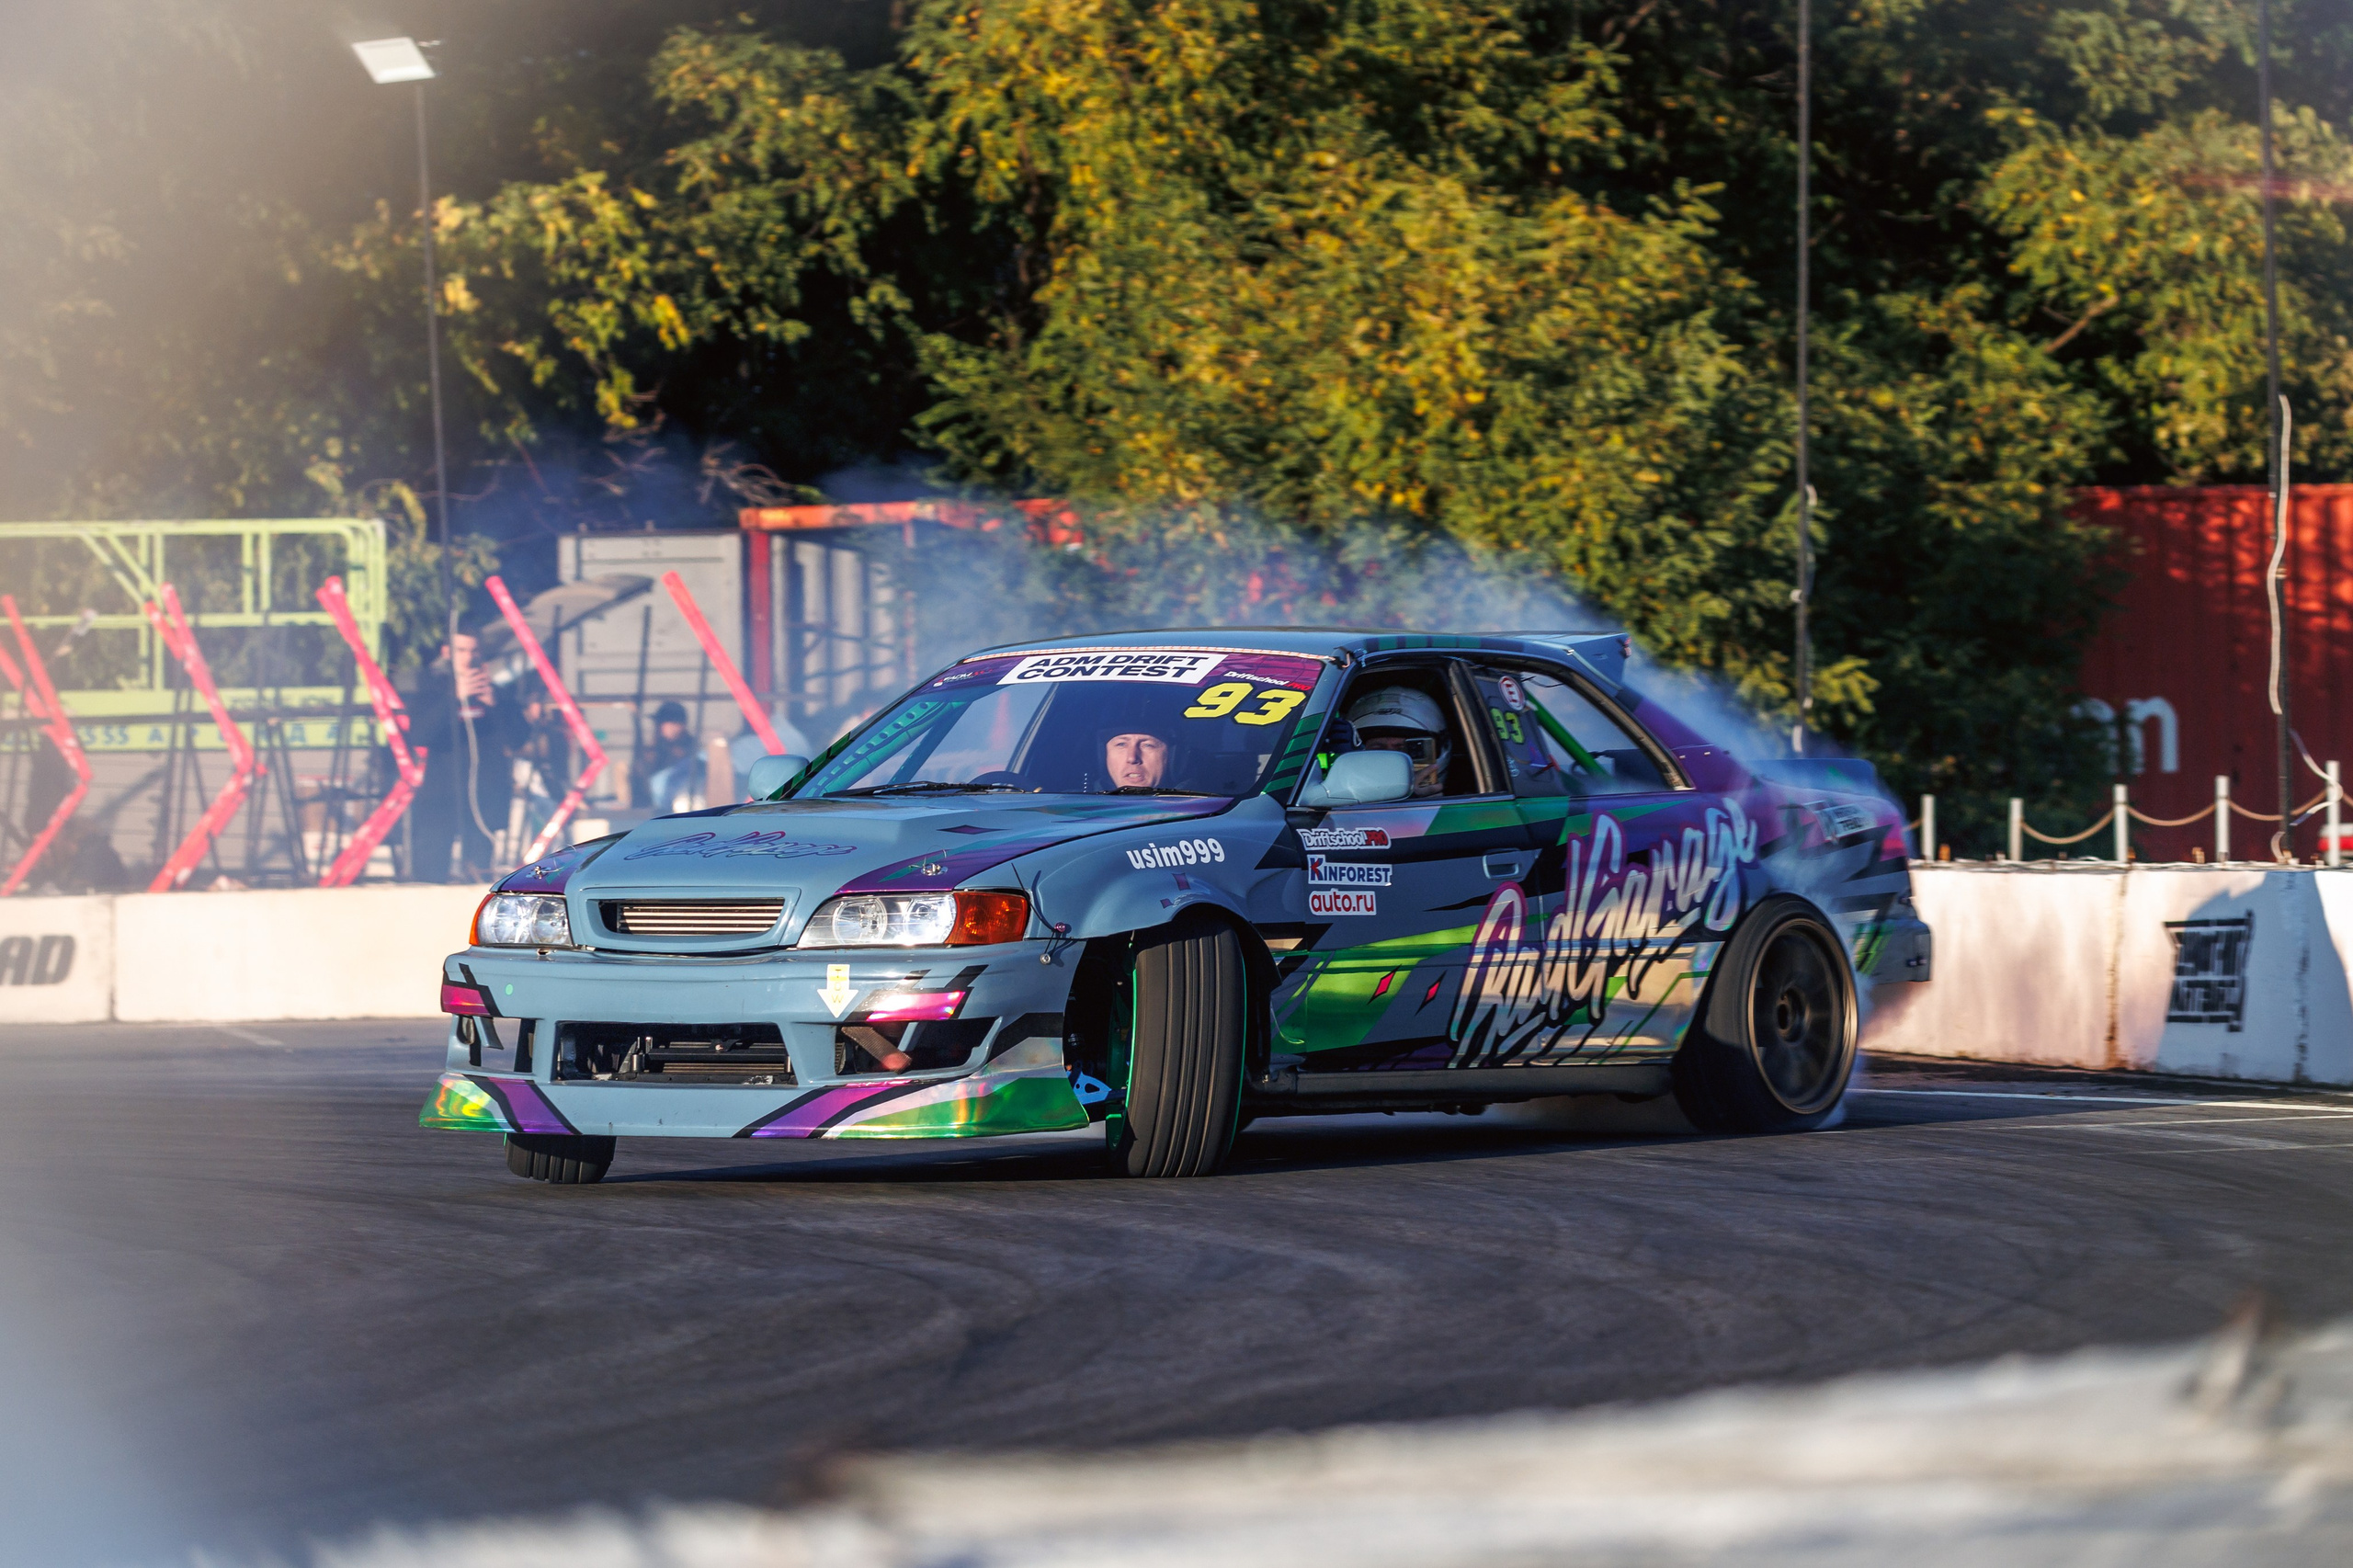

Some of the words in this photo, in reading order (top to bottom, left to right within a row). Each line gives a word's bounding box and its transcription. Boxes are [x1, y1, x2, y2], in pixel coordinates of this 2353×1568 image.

[1028, 655, 1107, 668] ADM
[1106, 653, 1210, 666] DRIFT
[1017, 665, 1198, 681] CONTEST
[1183, 682, 1307, 726] 93
[1126, 837, 1225, 869] usim999
[1309, 857, 1391, 883] KINFOREST
[1311, 891, 1375, 913] auto.ru
